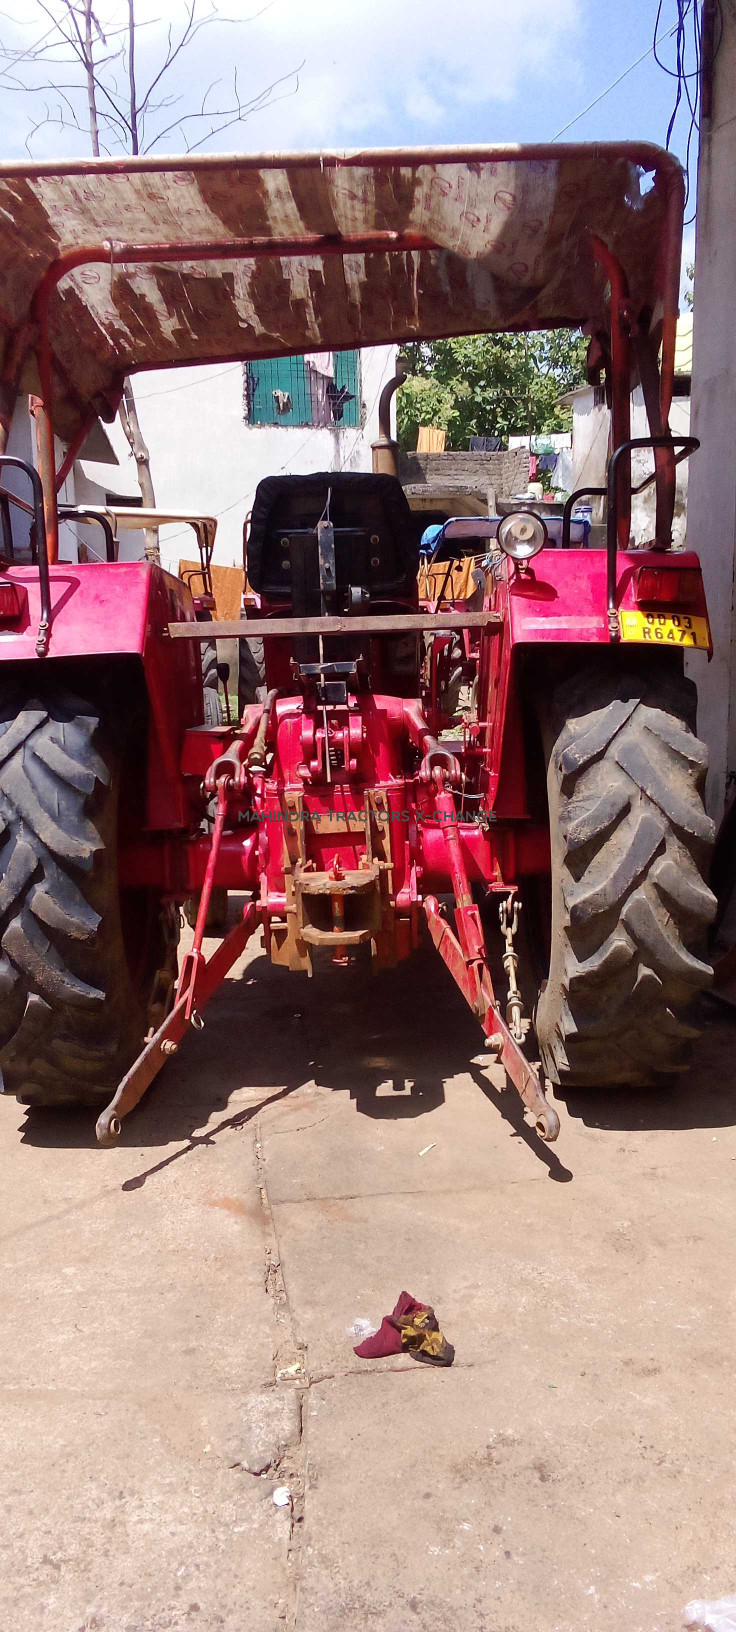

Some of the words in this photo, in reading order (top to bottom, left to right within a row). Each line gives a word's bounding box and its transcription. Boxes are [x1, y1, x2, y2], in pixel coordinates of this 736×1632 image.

[646, 613, 666, 626] OD
[672, 614, 692, 629] 03
[642, 627, 697, 645] R6471
